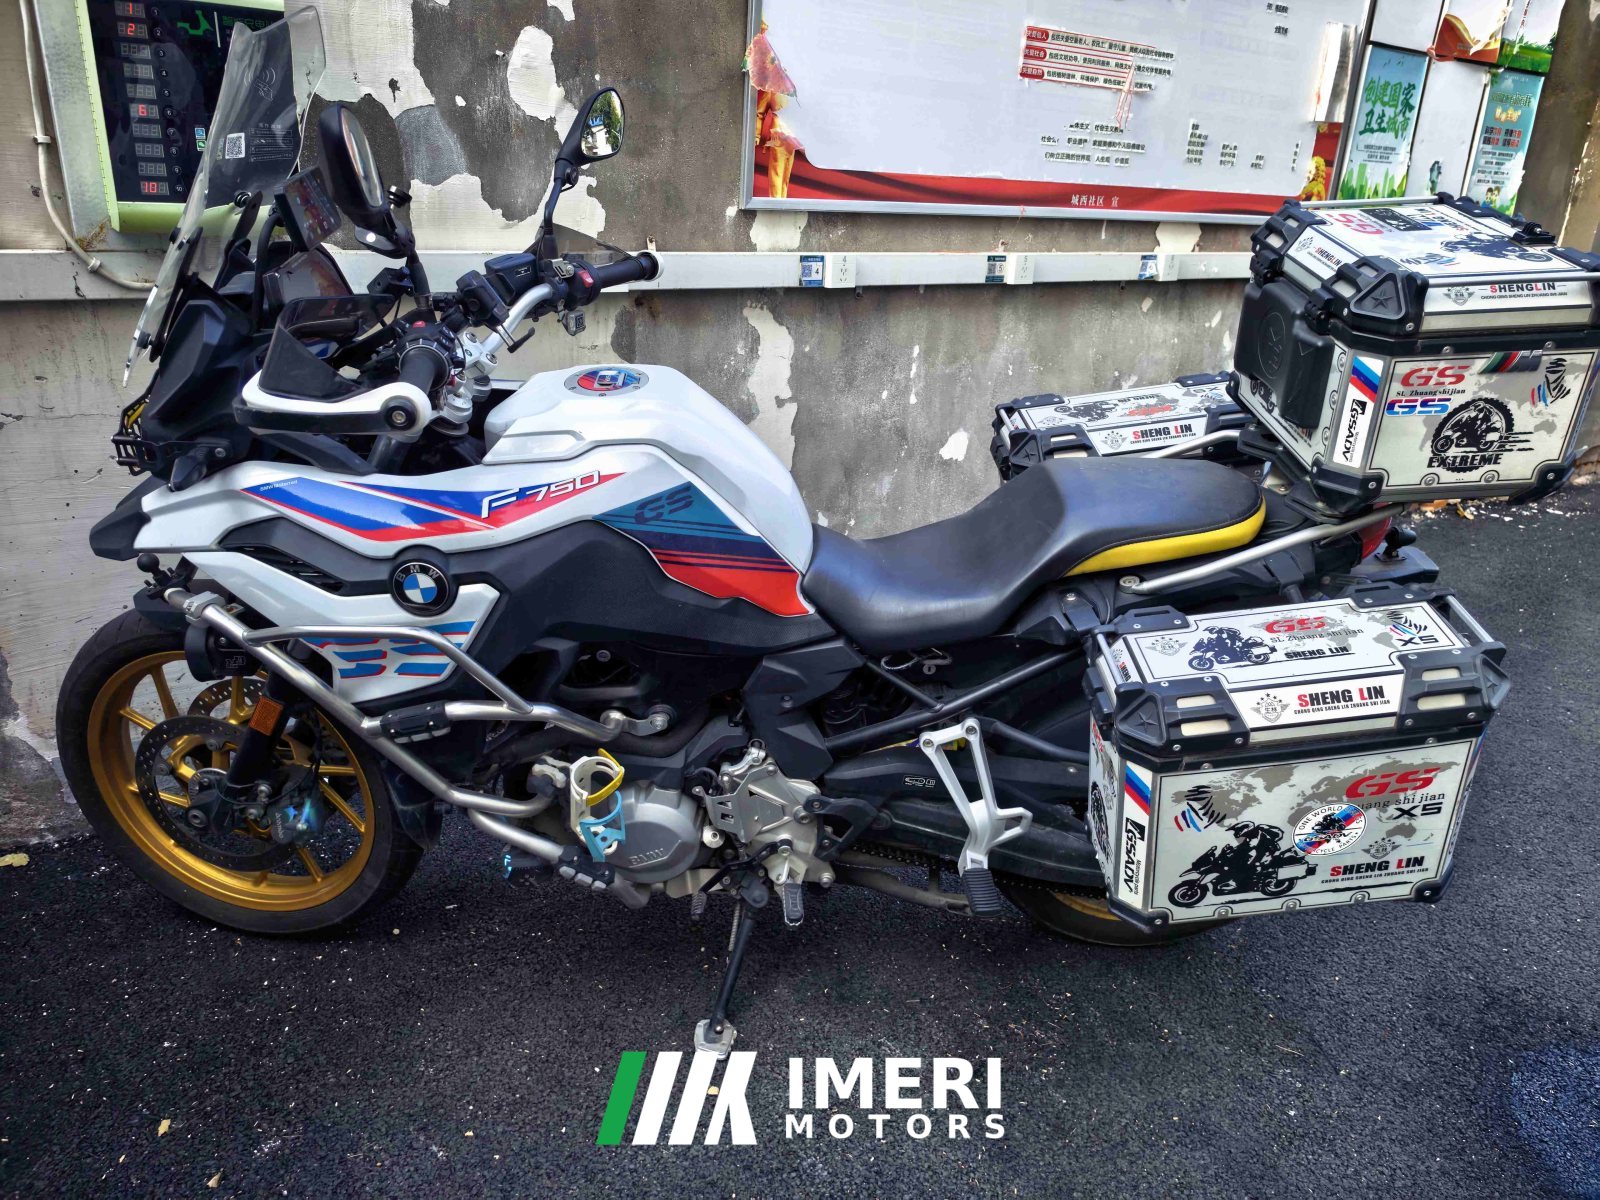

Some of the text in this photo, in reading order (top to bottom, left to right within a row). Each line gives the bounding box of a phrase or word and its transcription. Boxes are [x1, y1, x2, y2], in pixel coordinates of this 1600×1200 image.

[127, 23, 136, 36] 2
[1365, 77, 1416, 118] 创建国家
[1359, 108, 1411, 141] 卫生城市
[144, 182, 157, 193] 10
[1071, 194, 1104, 207] 城西社区
[1490, 282, 1556, 294] SHENGLIN
[1400, 365, 1471, 387] GS
[1385, 397, 1455, 416] GS
[1132, 424, 1193, 440] SHENG LIN
[1427, 453, 1503, 468] EXTREME
[481, 470, 600, 519] F 750
[634, 486, 694, 524] GS
[396, 564, 440, 583] BMW
[1265, 616, 1326, 634] GS
[1285, 646, 1350, 659] SHENG LIN
[1297, 685, 1385, 708] SHENG LIN
[1345, 767, 1441, 799] GS
[1418, 792, 1445, 804] jian
[1298, 817, 1312, 831] ONE
[1311, 805, 1343, 818] WORLD
[1330, 856, 1425, 877] SHENG LIN
